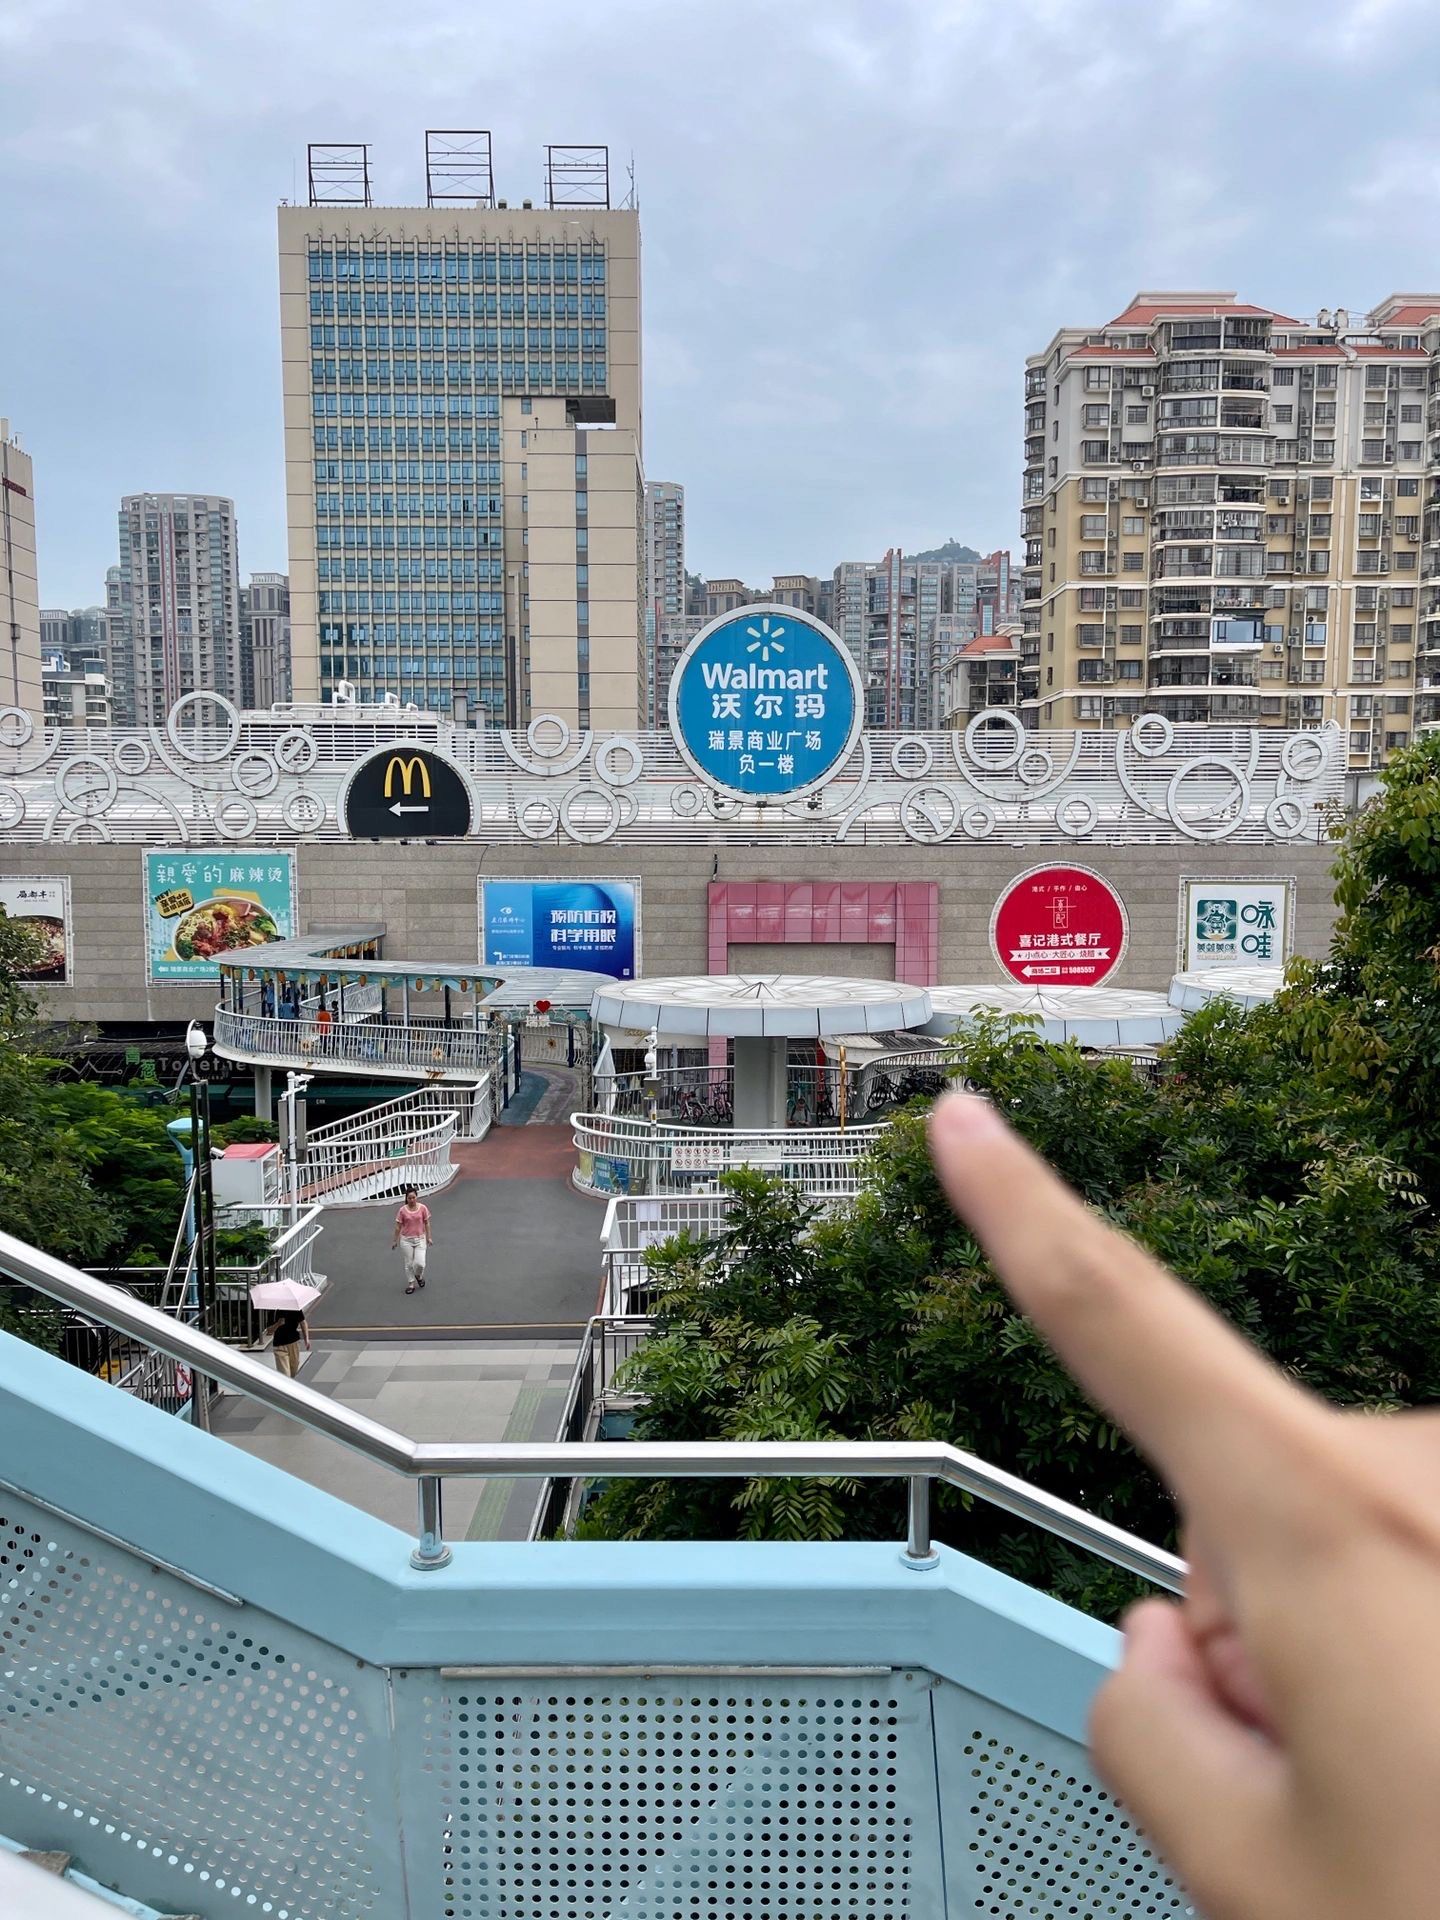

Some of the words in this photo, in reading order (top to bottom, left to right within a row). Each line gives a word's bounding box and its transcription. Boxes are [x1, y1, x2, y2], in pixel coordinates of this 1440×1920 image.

[701, 663, 828, 690] Walmart
[711, 694, 825, 719] 沃尔玛
[708, 730, 821, 751] 瑞景商业广场
[739, 754, 794, 775] 负一楼
[550, 910, 616, 924] 预防近视
[550, 929, 616, 943] 科学用眼
[1019, 933, 1102, 948] 喜记港式餐厅
